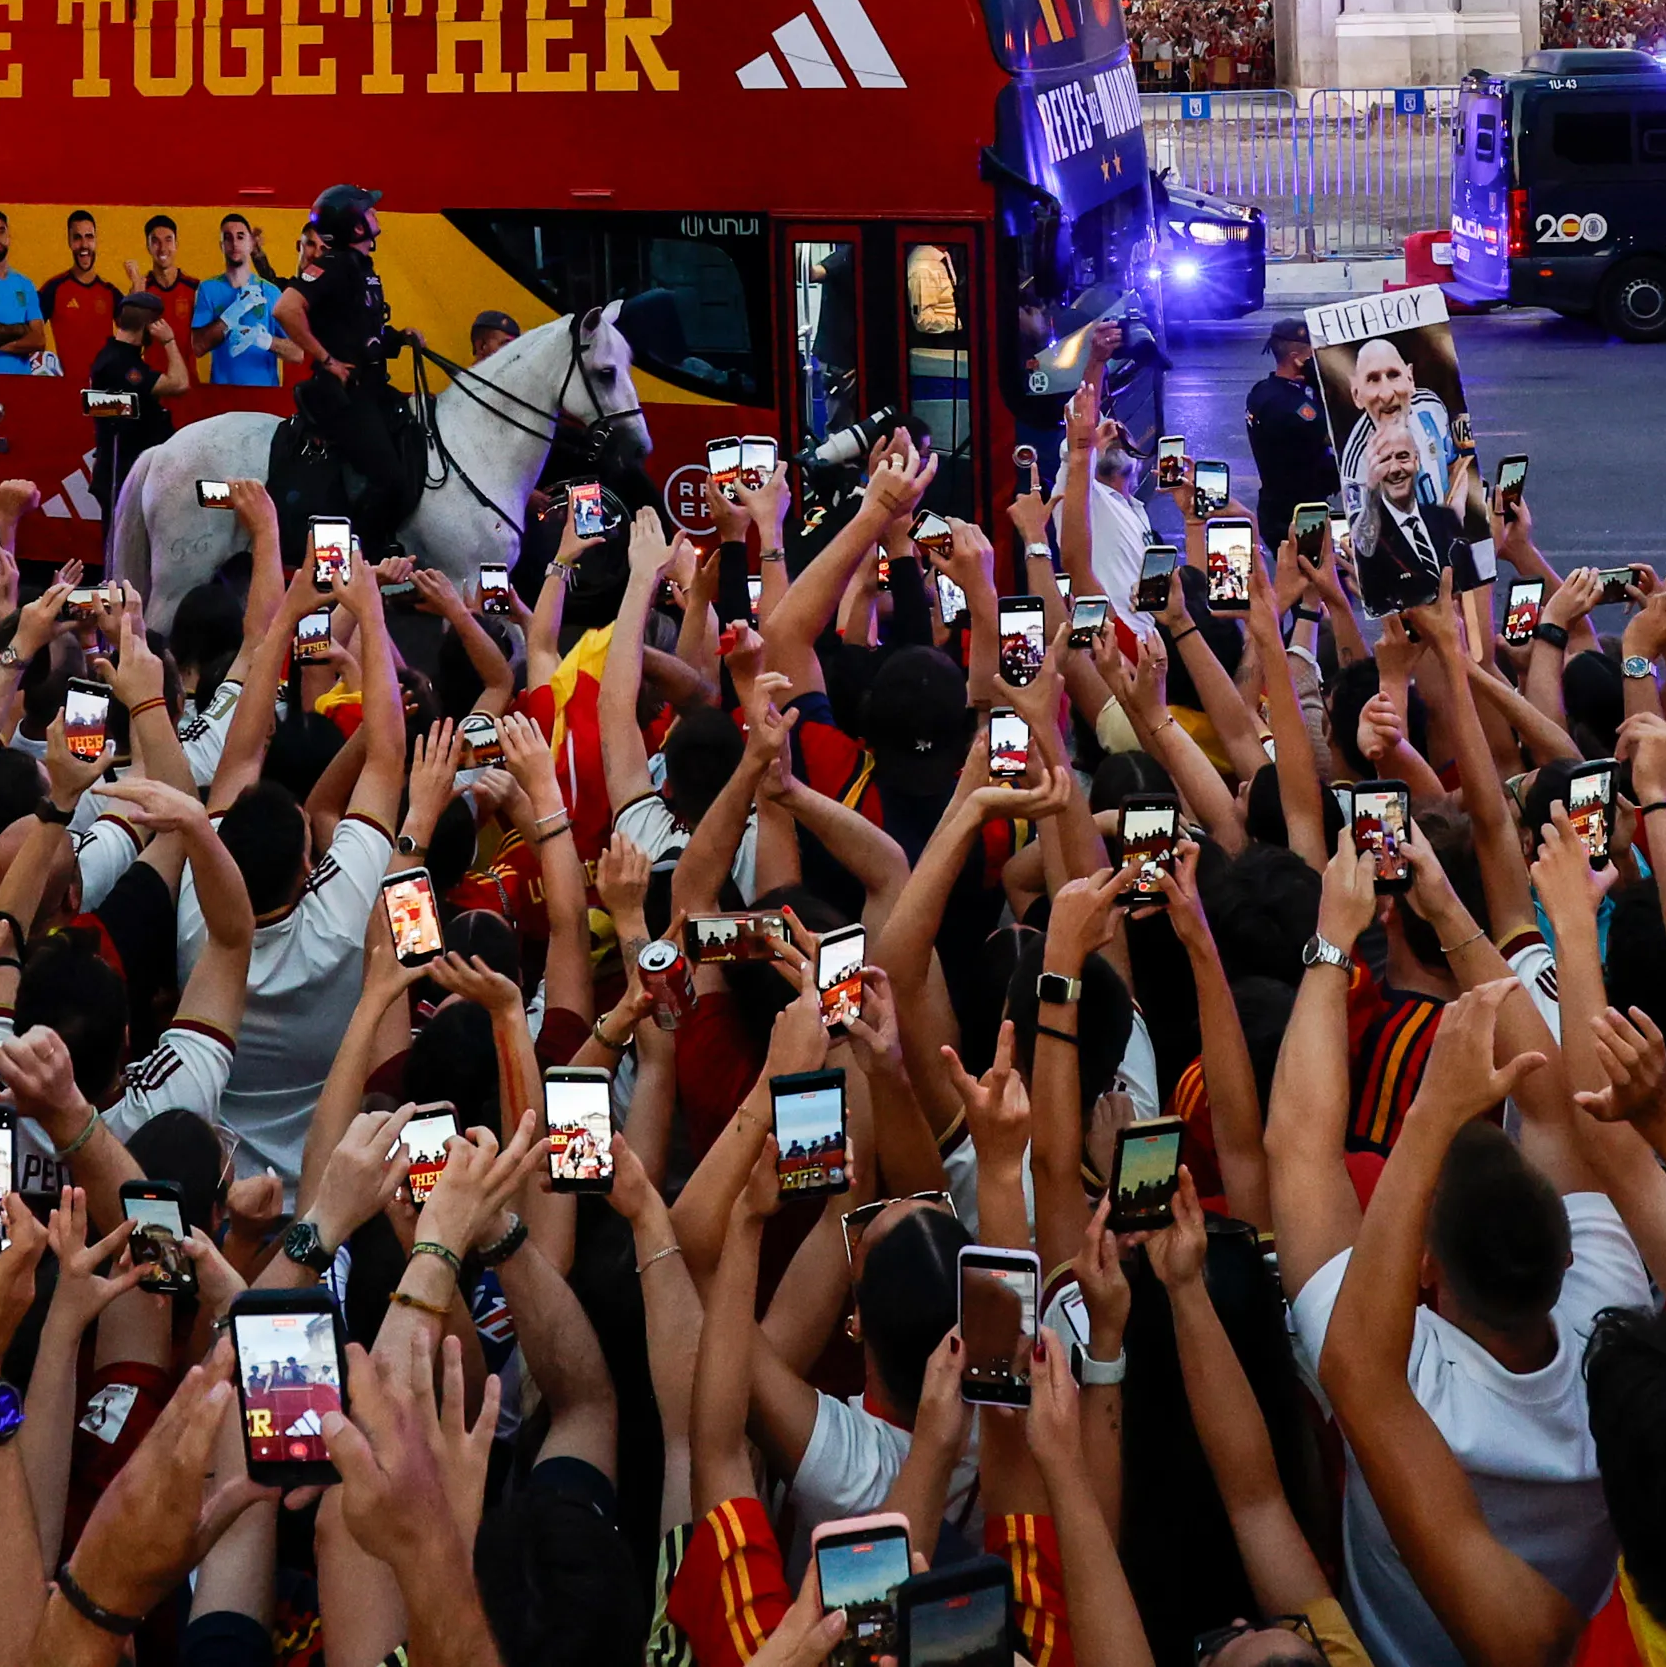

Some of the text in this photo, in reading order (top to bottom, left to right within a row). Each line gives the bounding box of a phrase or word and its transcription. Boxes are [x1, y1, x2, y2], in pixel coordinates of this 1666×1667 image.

[1548, 79, 1578, 90] 1U-43
[1037, 80, 1094, 165] REYES
[1535, 212, 1608, 243] 200
[1318, 294, 1421, 342] FIFA BOY
